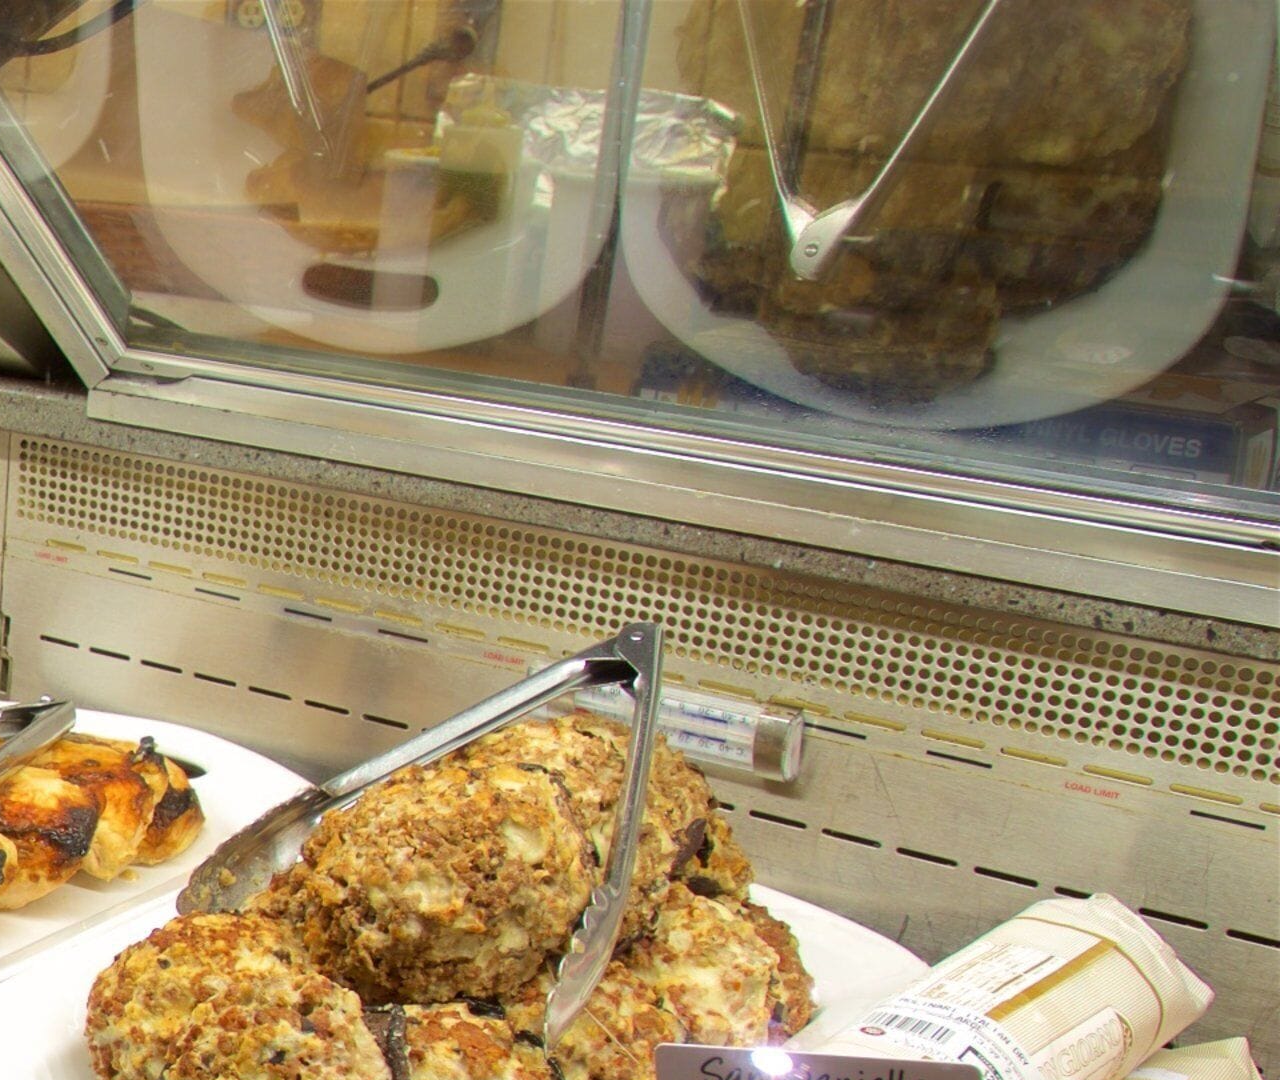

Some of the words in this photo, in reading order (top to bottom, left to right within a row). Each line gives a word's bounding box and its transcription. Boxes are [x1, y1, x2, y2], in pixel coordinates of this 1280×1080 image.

[1100, 428, 1202, 459] GLOVES
[966, 1012, 1011, 1045] ITALIAN
[1012, 1047, 1029, 1066] DRY
